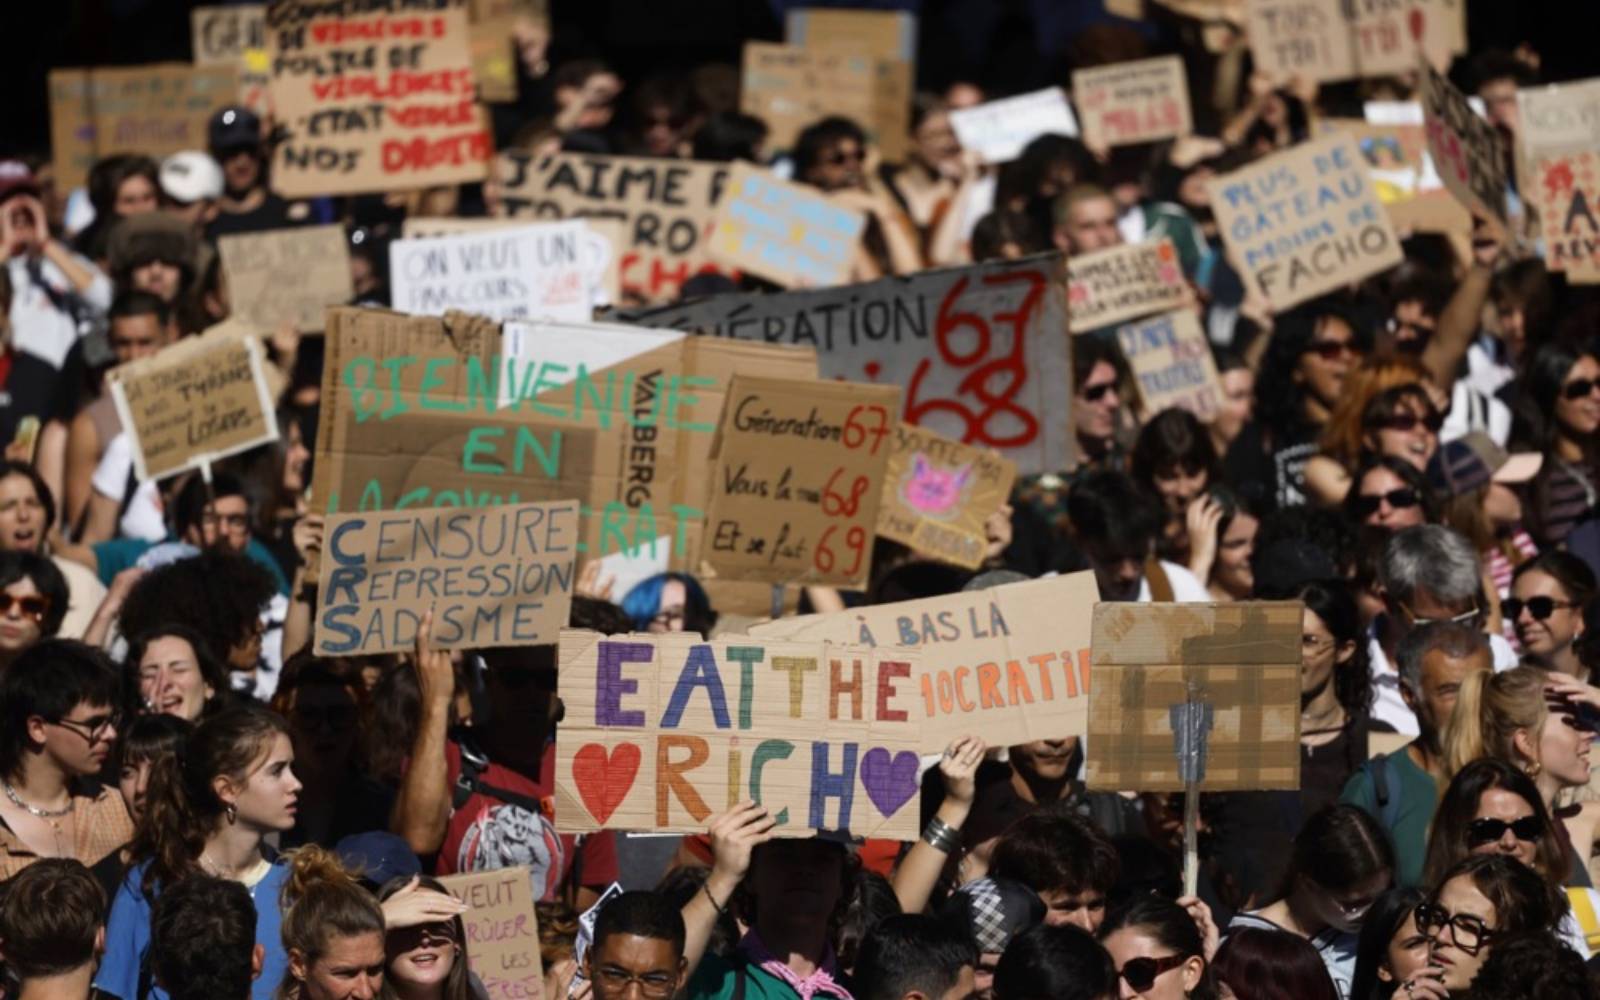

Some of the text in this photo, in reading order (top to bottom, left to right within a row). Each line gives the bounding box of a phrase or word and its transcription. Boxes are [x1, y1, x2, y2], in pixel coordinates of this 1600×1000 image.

[503, 156, 691, 206] J'AIME
[536, 230, 578, 267] UN
[1255, 224, 1388, 297] FACHO
[935, 270, 1047, 368] 67
[342, 353, 719, 432] BIENVENUE
[903, 356, 1039, 447] 68
[463, 424, 564, 481] EN
[624, 368, 664, 509] VALBERG
[734, 395, 891, 455] Génération 67
[821, 466, 869, 517] 68
[330, 506, 574, 567] CENSURE
[813, 524, 866, 576] 69
[897, 611, 961, 646] BAS
[967, 601, 1011, 639] LA
[594, 641, 912, 731] EAT THE
[452, 879, 519, 909] VEUT
[466, 913, 534, 943] RÛLER
